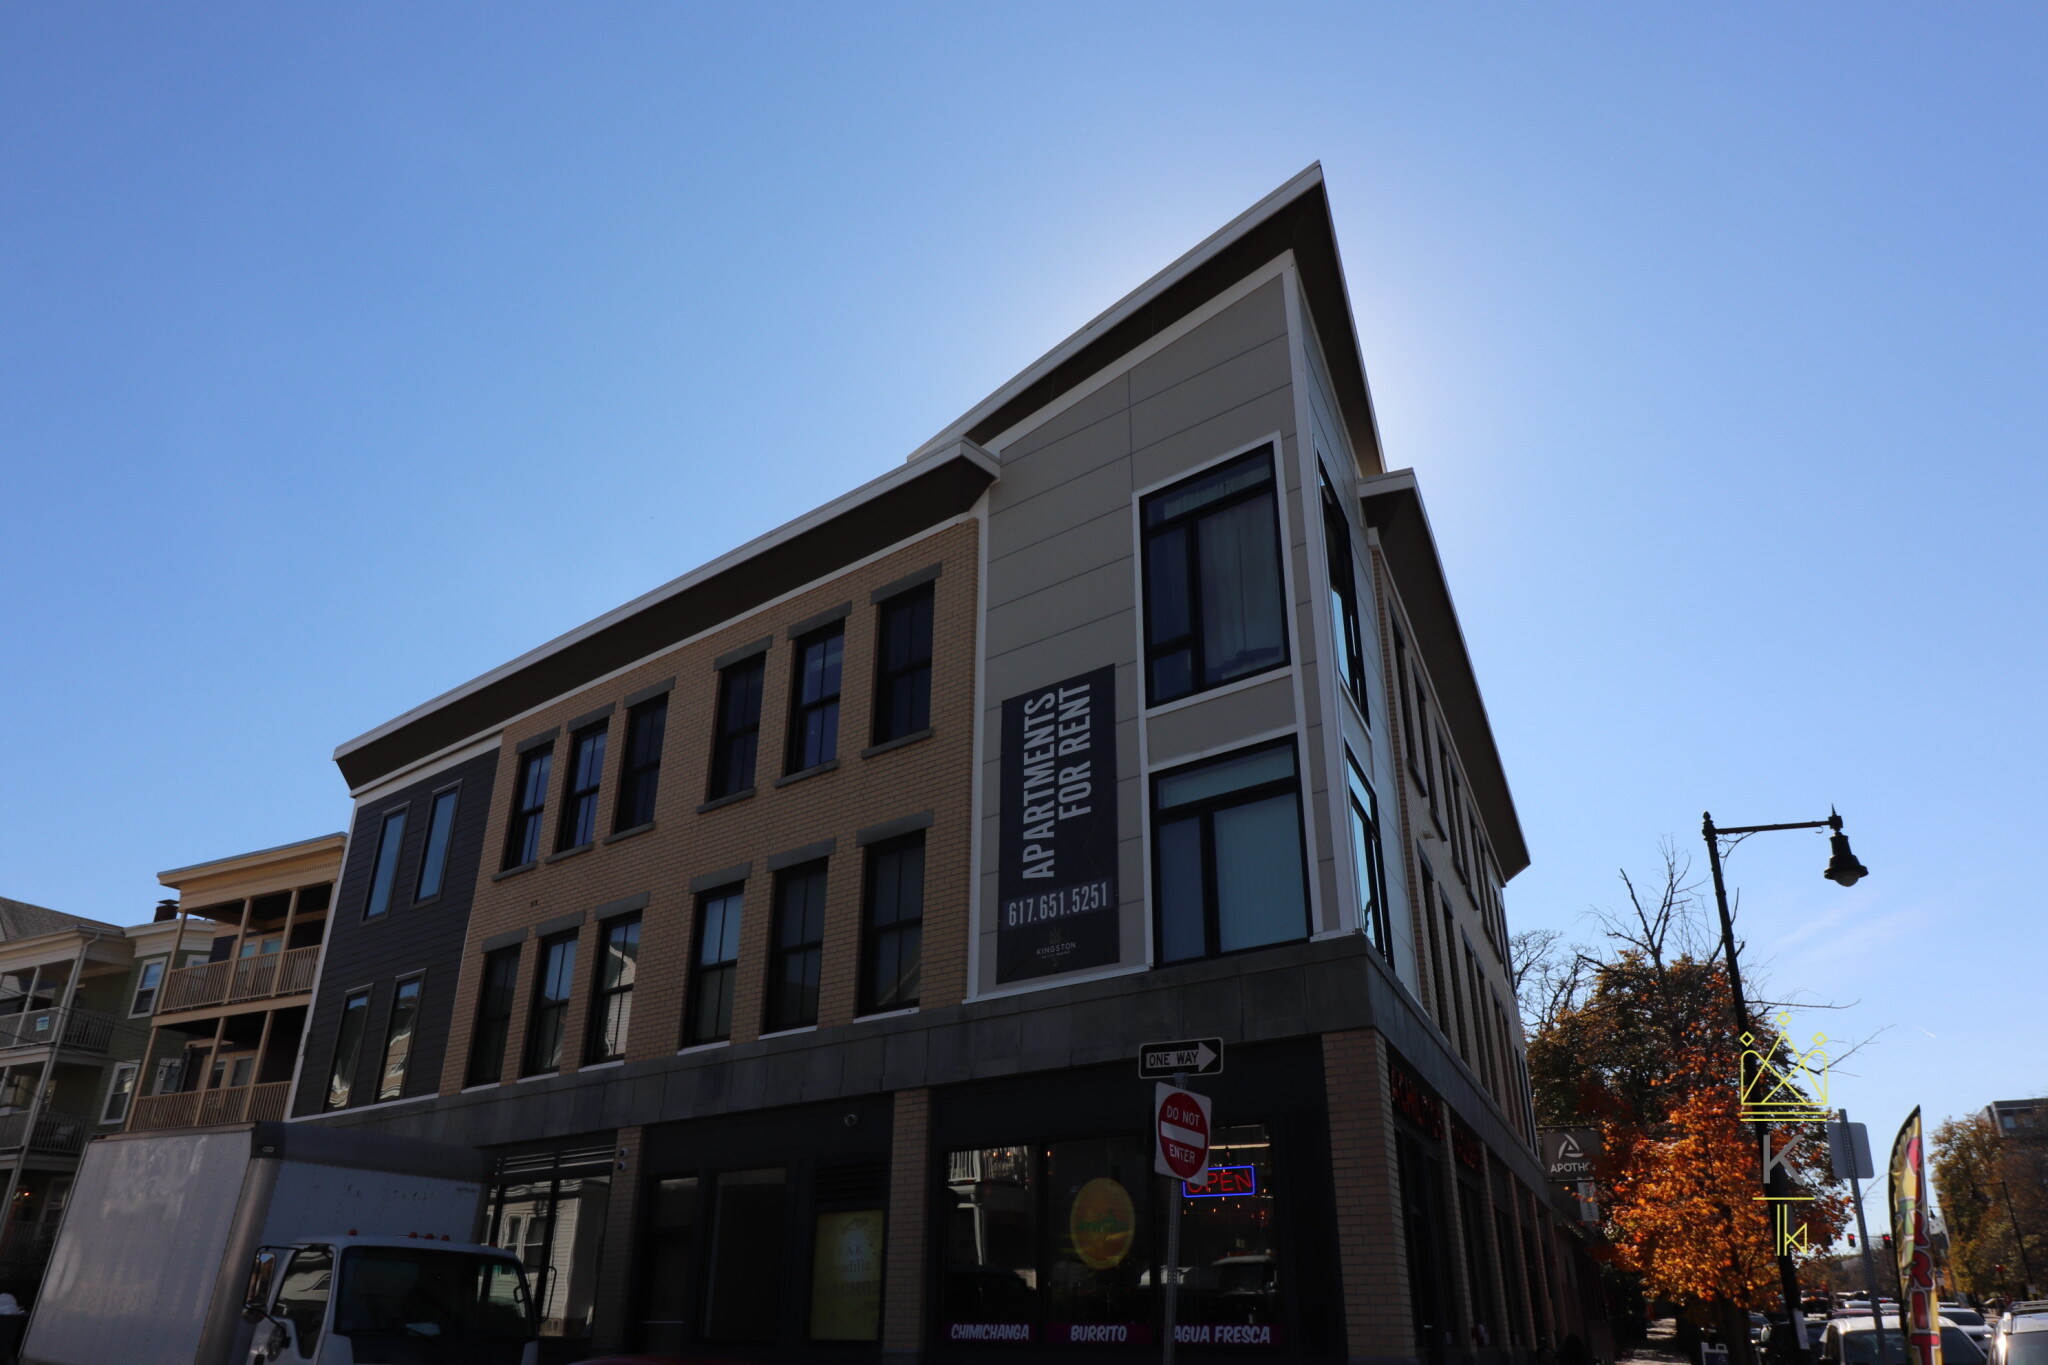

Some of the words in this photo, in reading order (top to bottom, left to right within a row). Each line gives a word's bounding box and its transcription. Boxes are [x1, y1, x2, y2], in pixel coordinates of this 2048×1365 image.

[1058, 683, 1091, 757] RENT
[1023, 693, 1055, 879] APARTMENTS
[1058, 760, 1091, 821] FOR
[1008, 882, 1107, 927] 617.651.5251
[1036, 941, 1076, 956] KINGSTON
[1148, 1053, 1171, 1067] ONE
[1176, 1050, 1199, 1066] WAY
[1166, 1106, 1179, 1121] DO
[1182, 1111, 1200, 1128] NOT
[1169, 1144, 1196, 1164] ENTER
[951, 1323, 1030, 1340] CHIMICHANGA
[1070, 1324, 1128, 1342] BURRITO
[1173, 1325, 1210, 1343] AGUA
[1214, 1325, 1271, 1344] FRESCA
